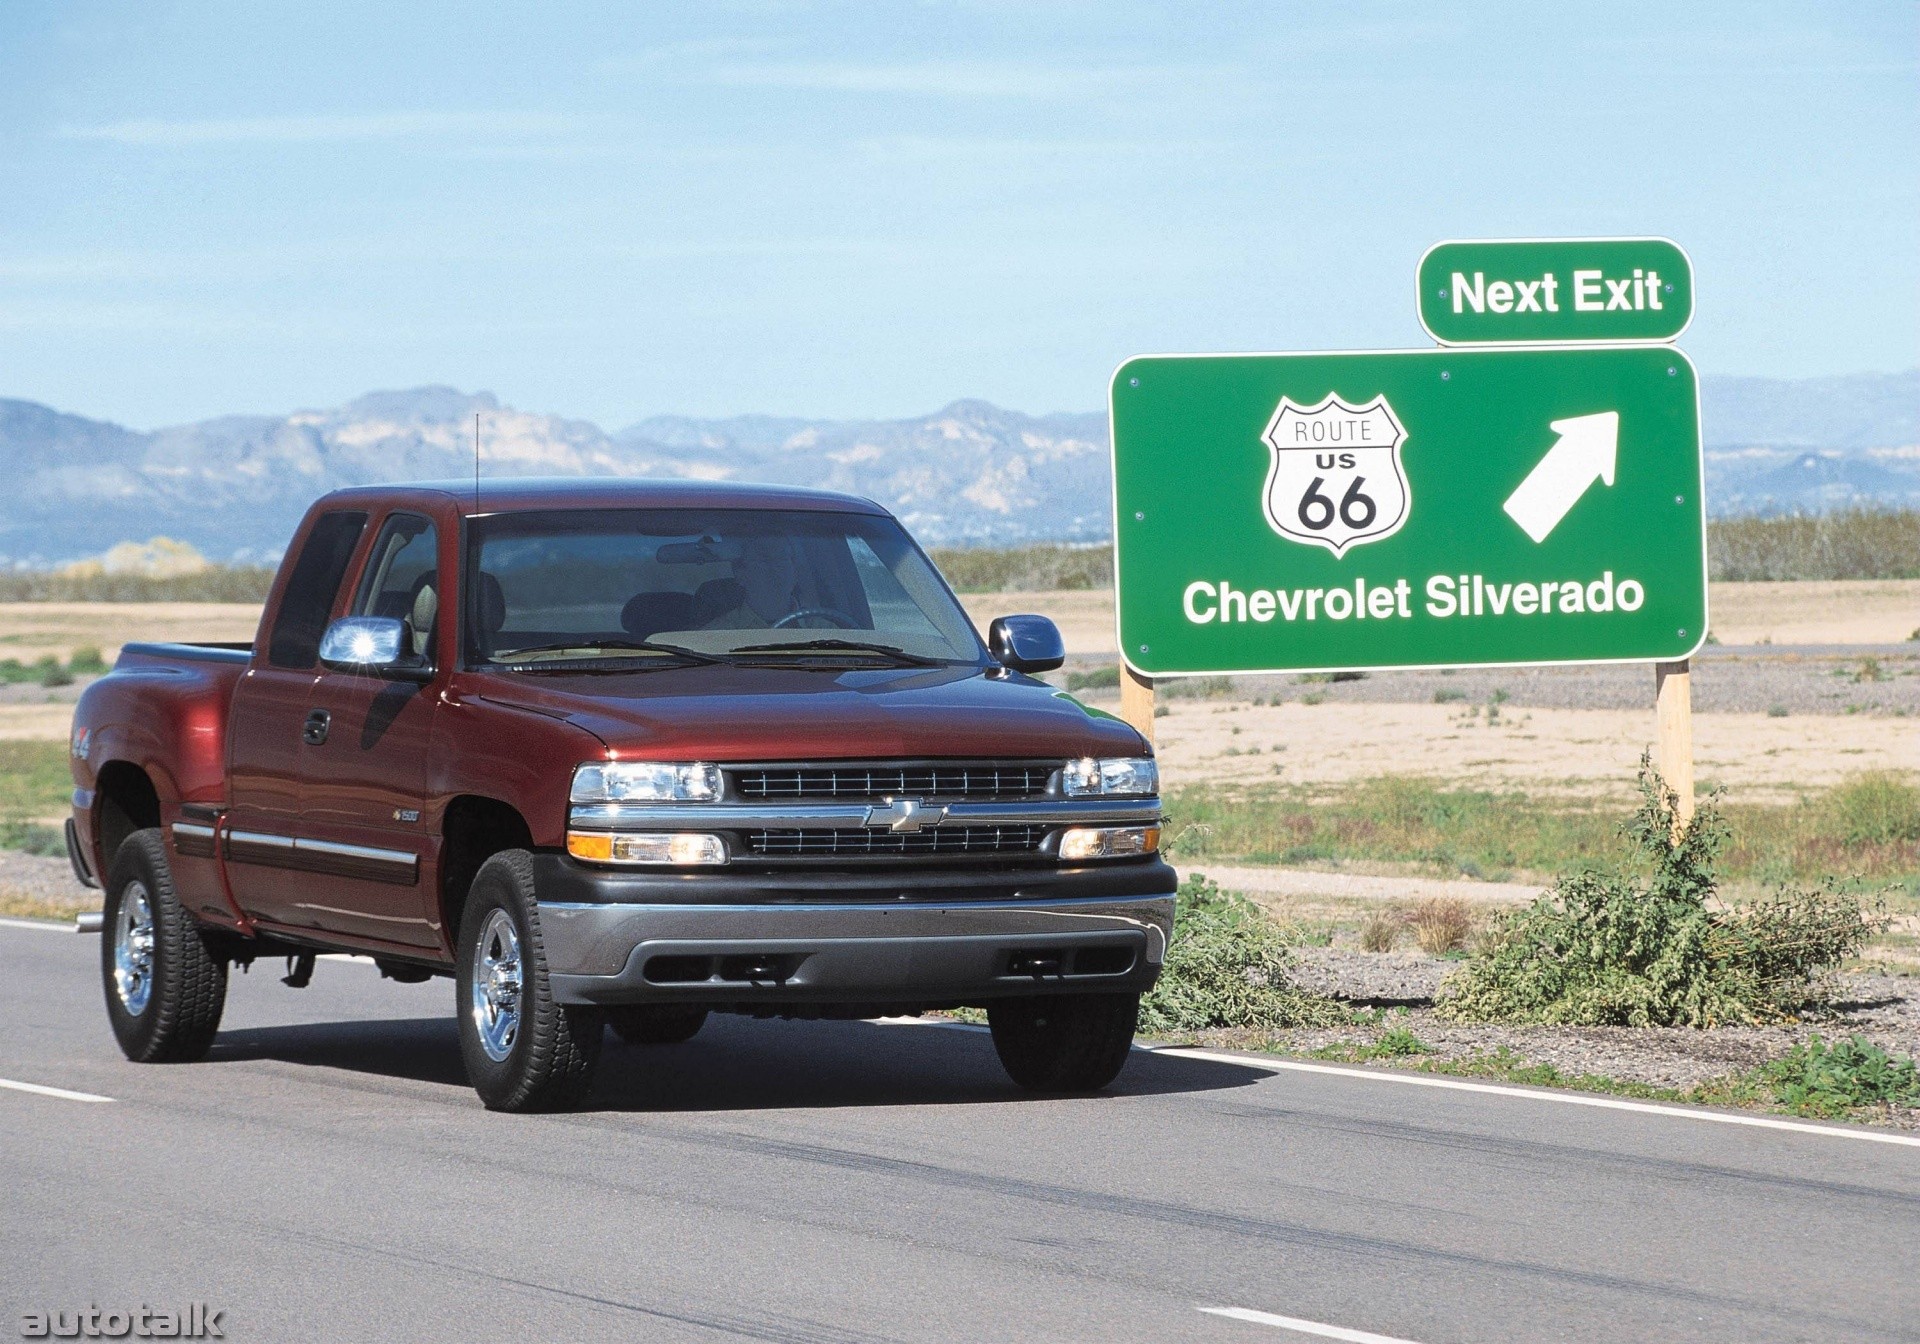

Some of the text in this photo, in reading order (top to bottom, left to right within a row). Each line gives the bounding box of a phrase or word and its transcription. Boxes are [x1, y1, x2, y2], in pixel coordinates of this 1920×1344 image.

[1451, 269, 1664, 314] Next Exit
[1294, 420, 1372, 442] ROUTE
[1315, 453, 1357, 470] US
[1297, 475, 1377, 531] 66
[1182, 571, 1645, 625] Chevrolet Silverado
